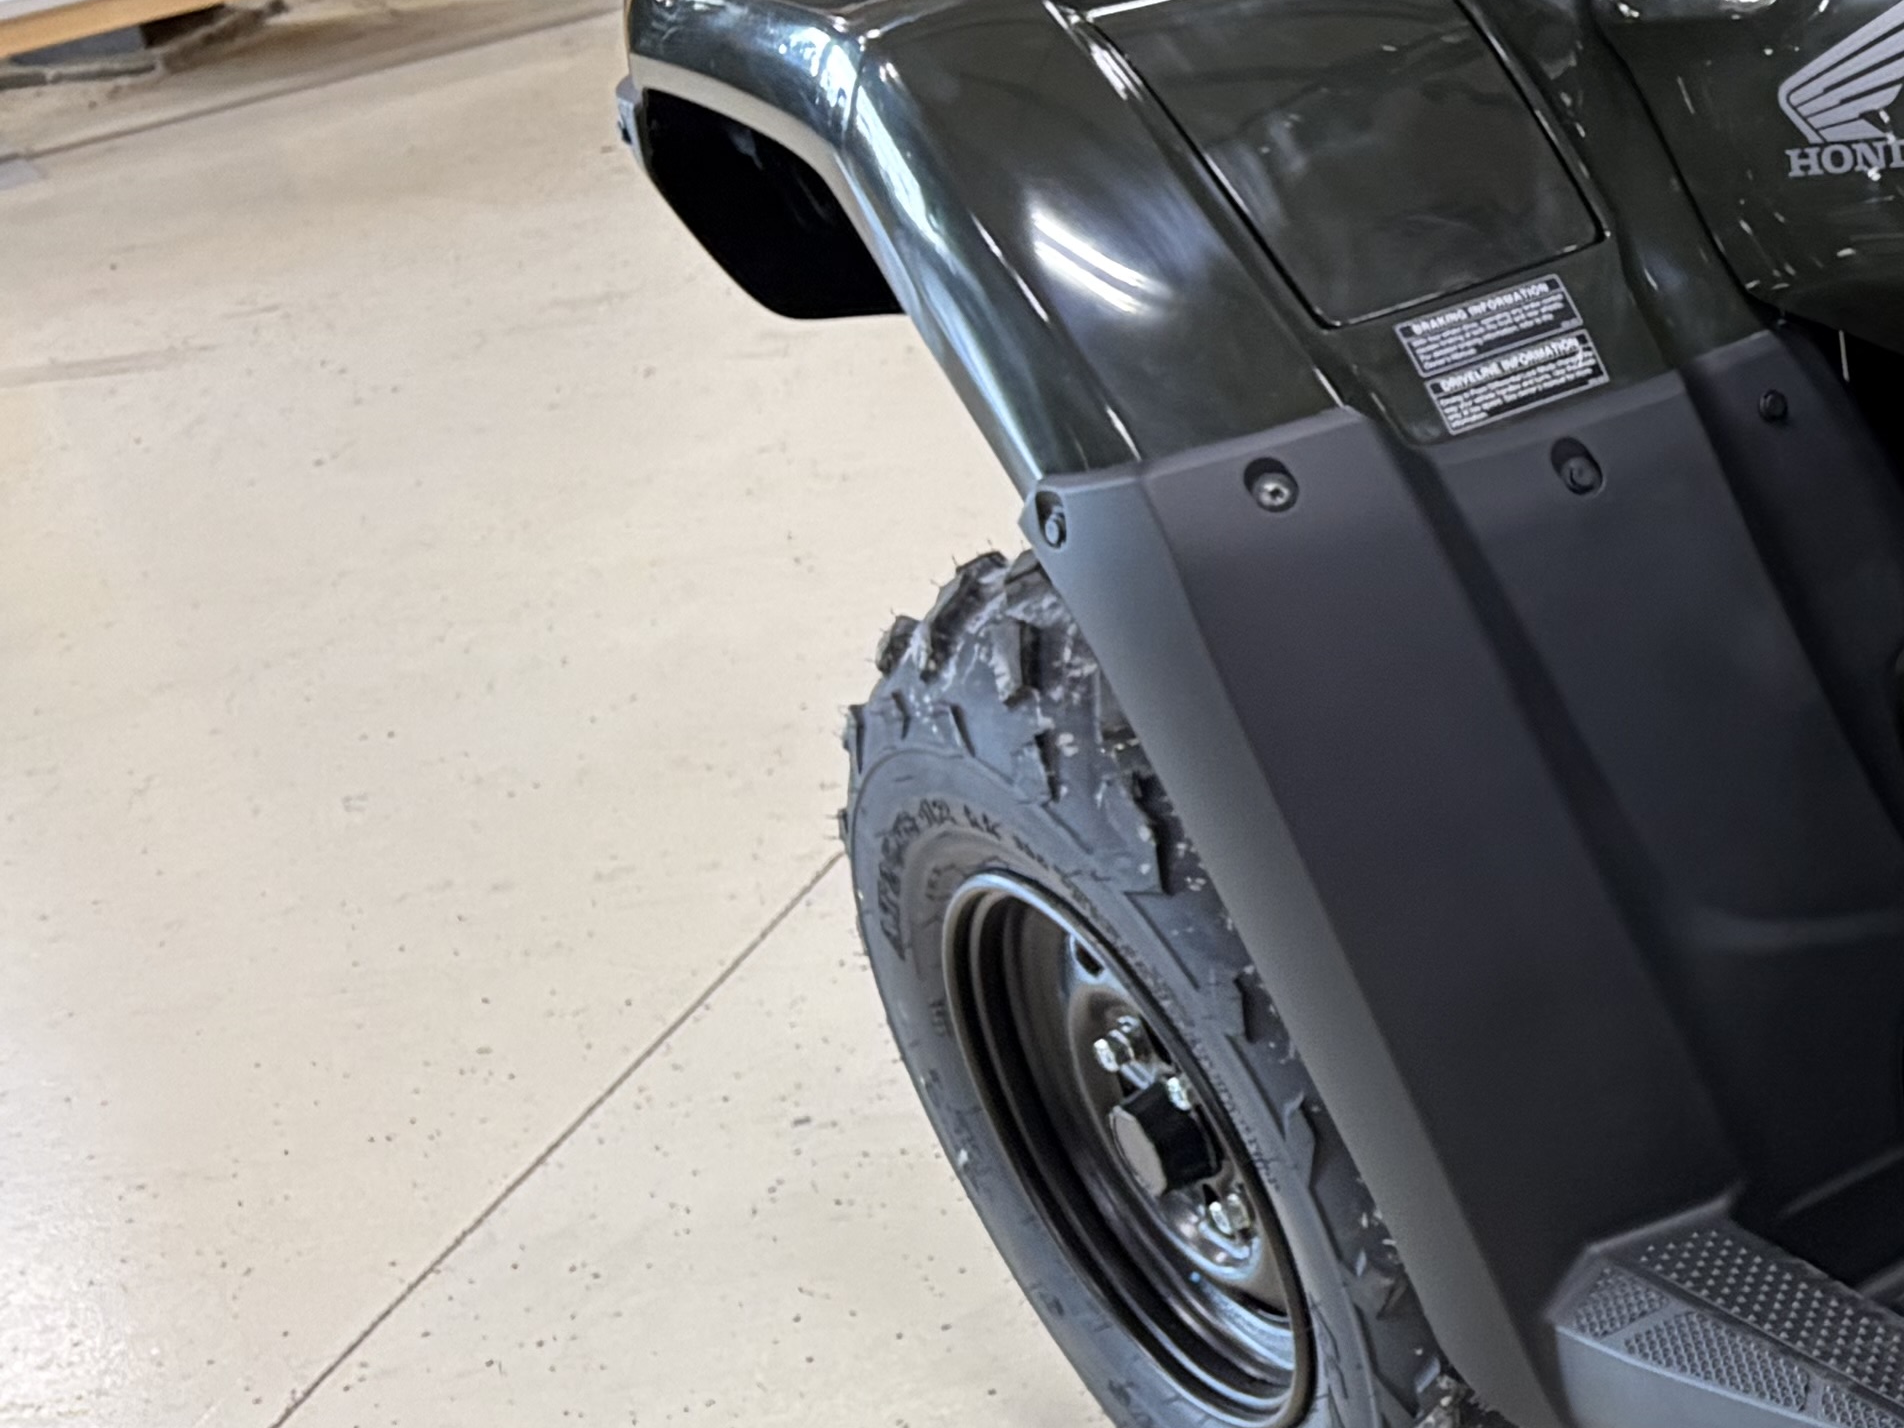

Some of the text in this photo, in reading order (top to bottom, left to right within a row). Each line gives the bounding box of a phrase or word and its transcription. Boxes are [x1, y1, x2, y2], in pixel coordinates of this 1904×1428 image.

[1411, 308, 1468, 336] BRAKING
[1467, 282, 1550, 317] INFORMATION
[1439, 362, 1501, 393] DRIVELINE
[1500, 337, 1580, 372] INFORMATION
